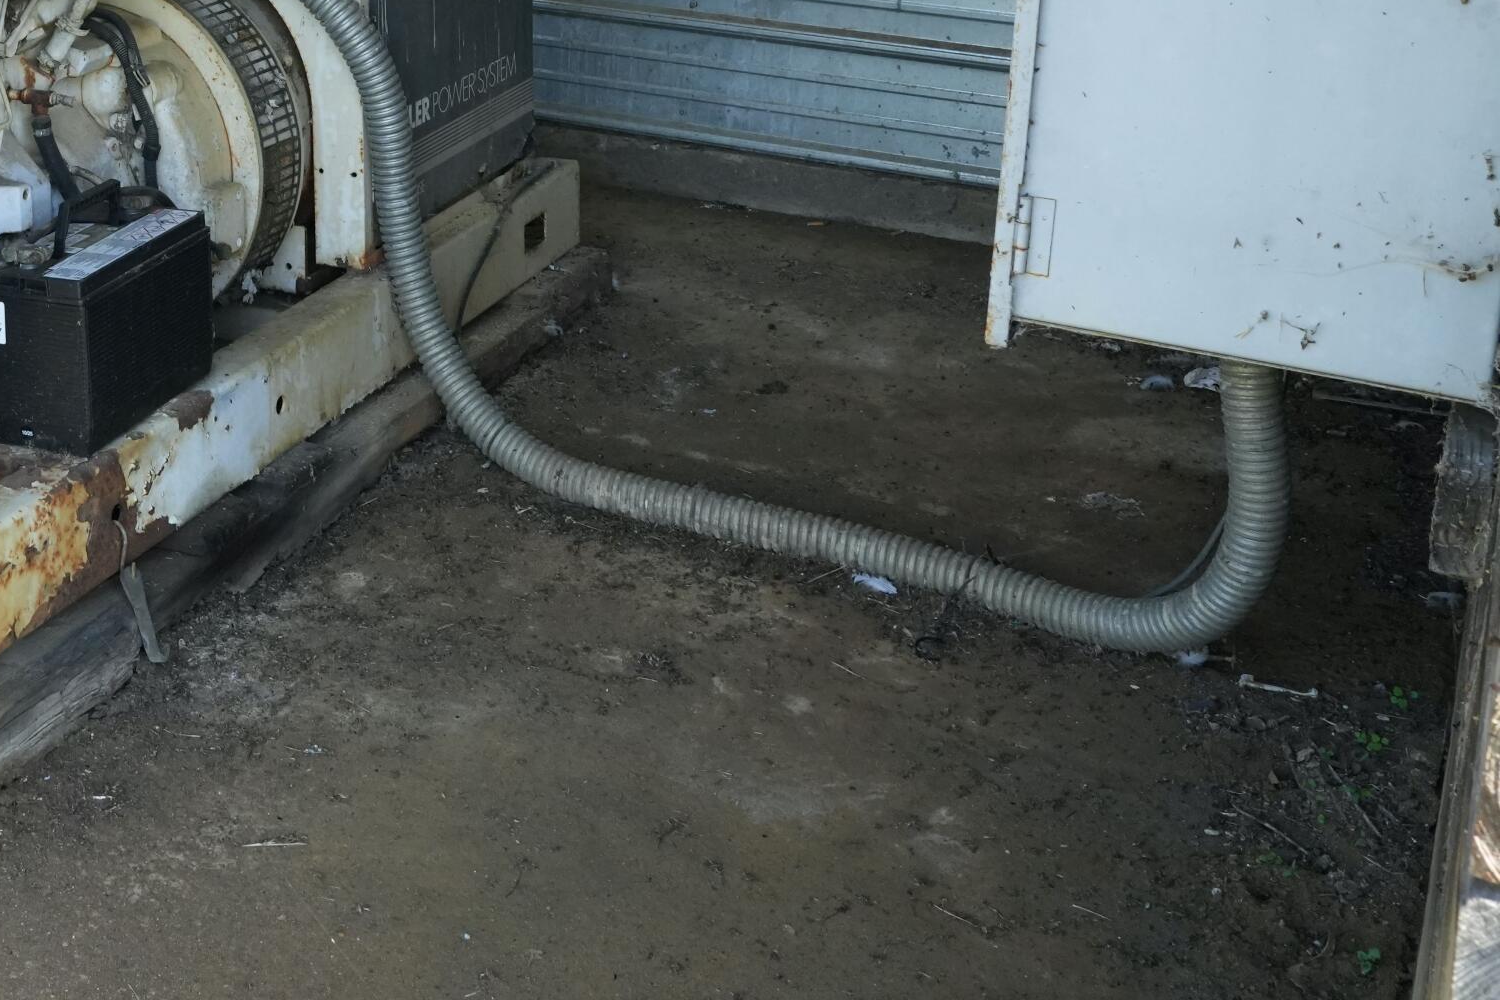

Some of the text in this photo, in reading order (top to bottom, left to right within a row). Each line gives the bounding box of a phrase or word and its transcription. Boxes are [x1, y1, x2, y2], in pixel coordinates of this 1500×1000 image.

[406, 50, 517, 129] LER POWER SYSTEM
